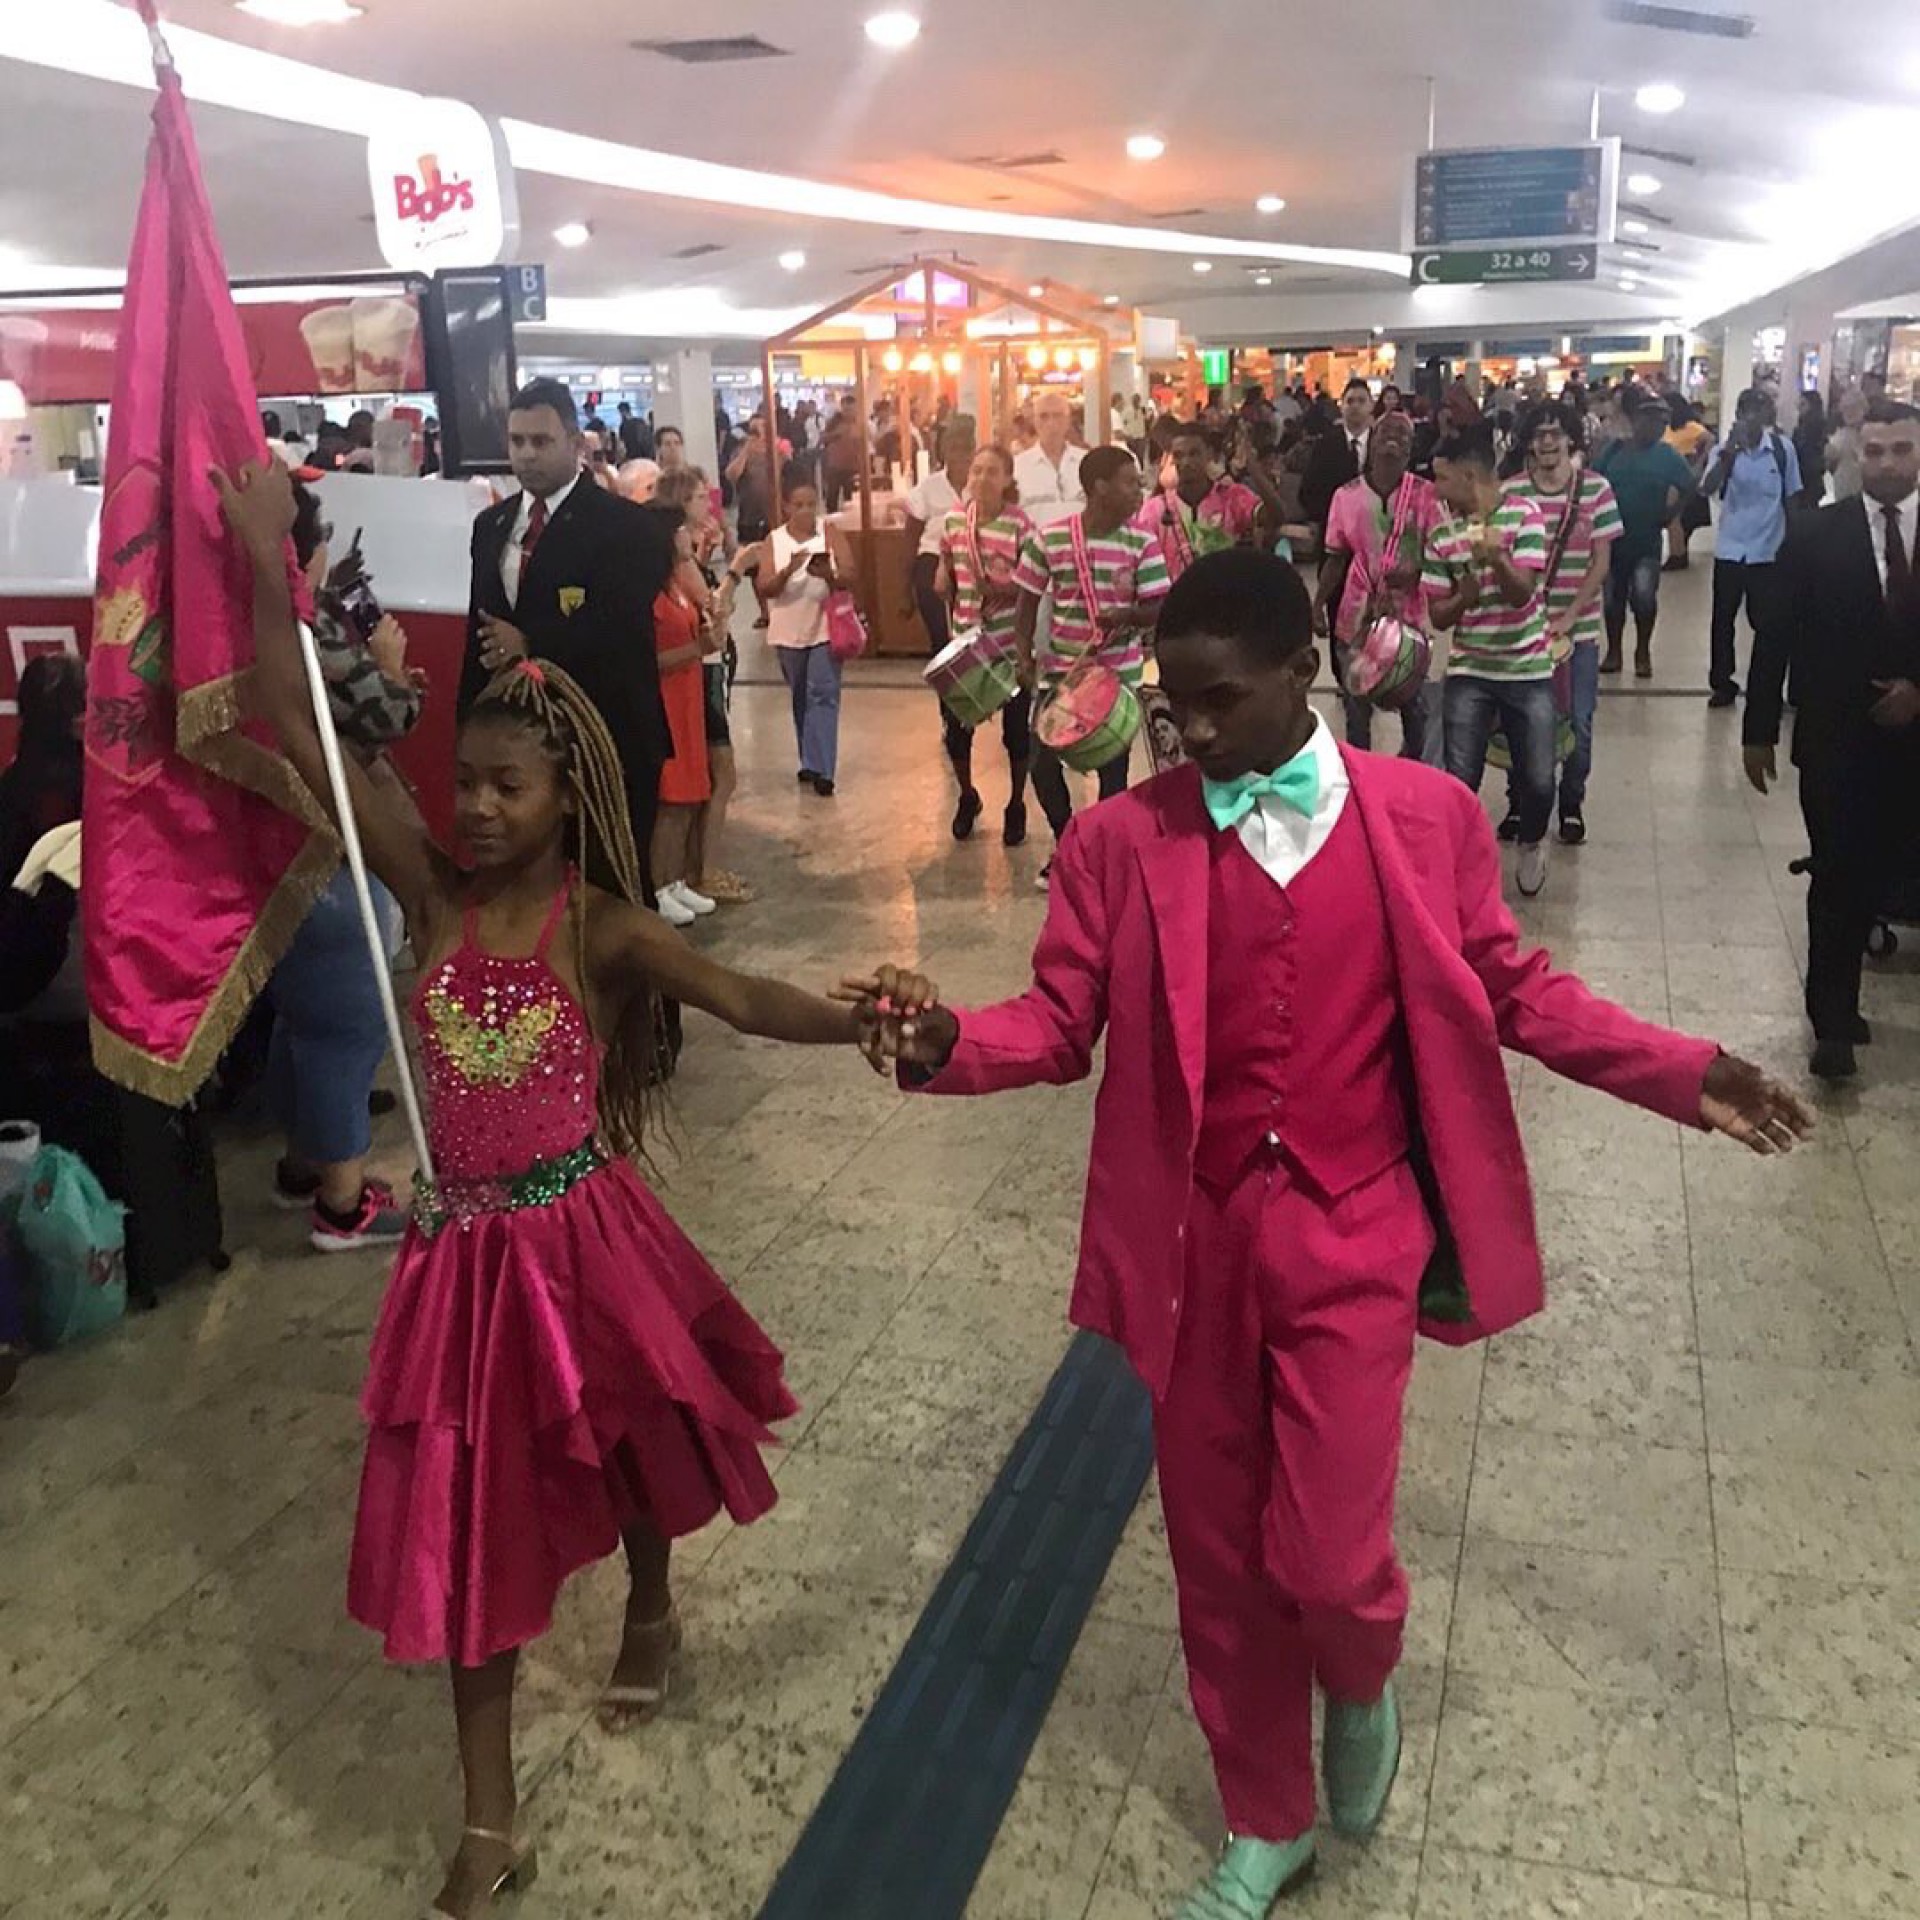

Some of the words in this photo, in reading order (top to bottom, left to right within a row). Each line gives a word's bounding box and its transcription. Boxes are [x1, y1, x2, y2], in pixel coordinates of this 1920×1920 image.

[394, 168, 474, 222] Bob's
[520, 267, 538, 292] B
[1418, 253, 1441, 282] C
[1491, 253, 1512, 269] 32
[1514, 255, 1526, 268] a
[1528, 252, 1551, 268] 40
[522, 296, 541, 320] C
